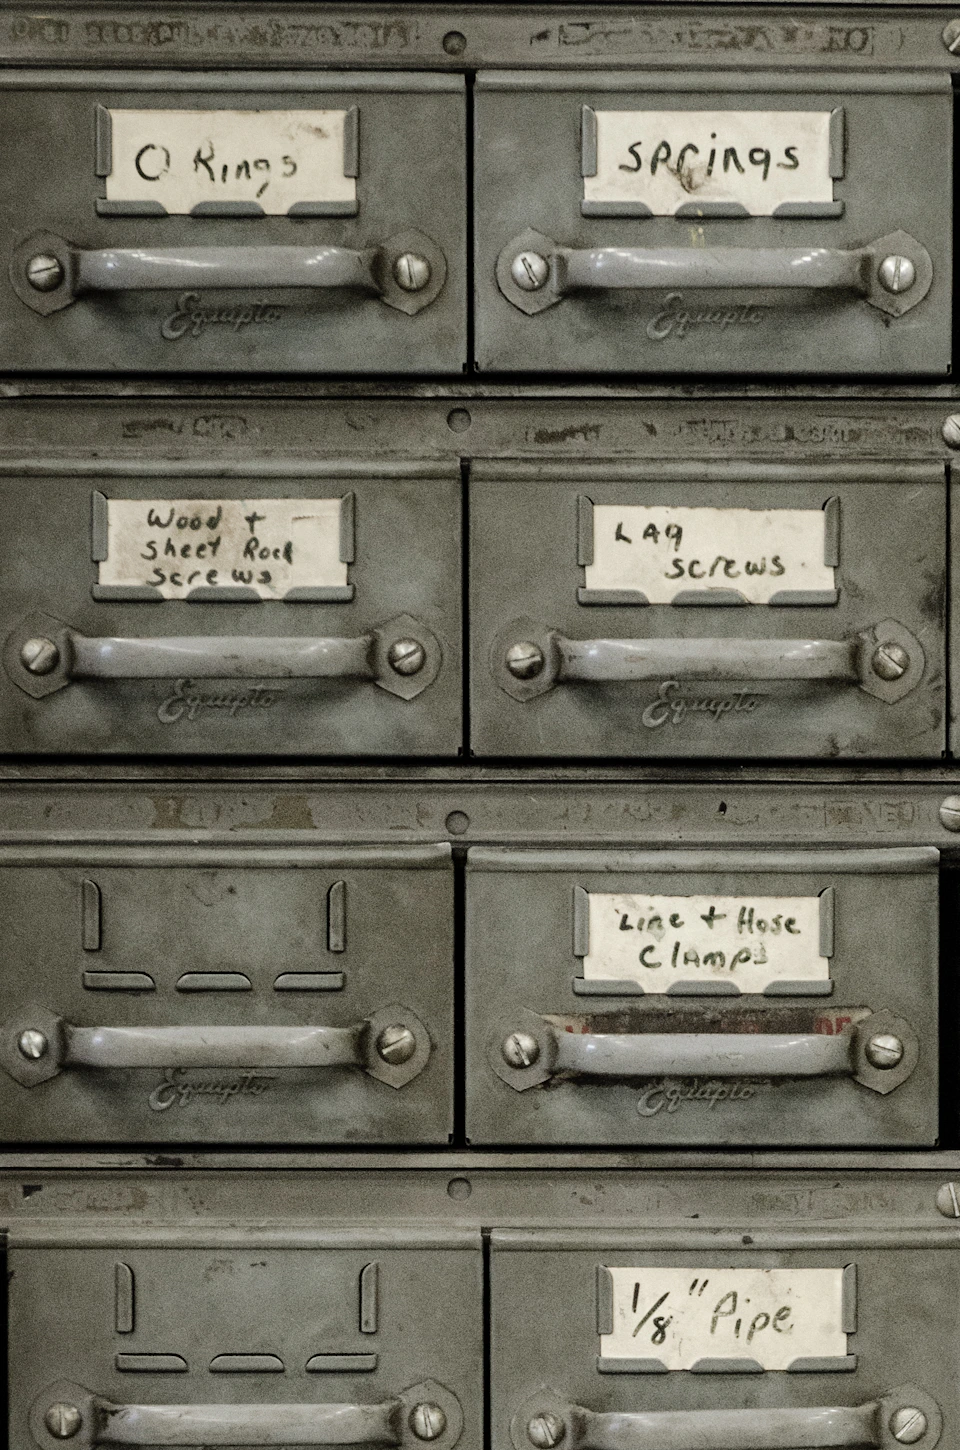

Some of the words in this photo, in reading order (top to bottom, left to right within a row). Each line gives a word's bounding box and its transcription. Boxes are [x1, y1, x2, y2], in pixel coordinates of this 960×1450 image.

[134, 143, 171, 181] O
[147, 505, 223, 531] Wood
[736, 906, 801, 934] Hose
[709, 1291, 794, 1345] Pipe
